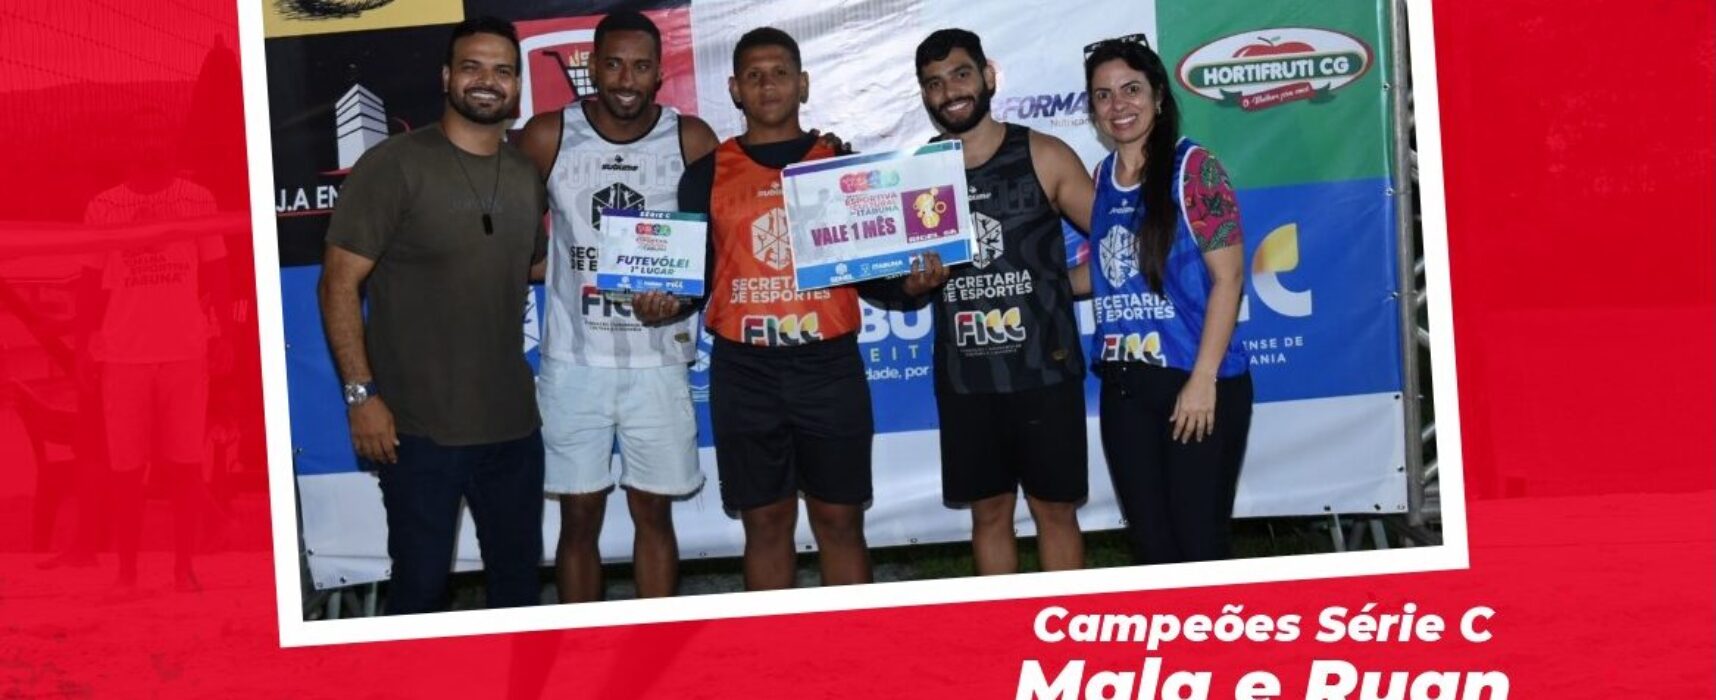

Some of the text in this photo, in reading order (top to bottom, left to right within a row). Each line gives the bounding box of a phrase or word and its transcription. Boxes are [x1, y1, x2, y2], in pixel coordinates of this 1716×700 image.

[1203, 56, 1350, 86] HORTIFRUTI CG
[275, 187, 311, 212] J.A
[811, 215, 897, 247] VALE 1 MÊS
[568, 246, 599, 259] SEC
[616, 255, 690, 269] FUTEVÓLEI
[641, 267, 675, 275] LUGAR
[751, 289, 831, 304] ESPORTES
[960, 280, 1034, 301] ESPORTES
[955, 307, 1027, 346] FICC
[1284, 336, 1304, 348] DE
[905, 365, 930, 381] por
